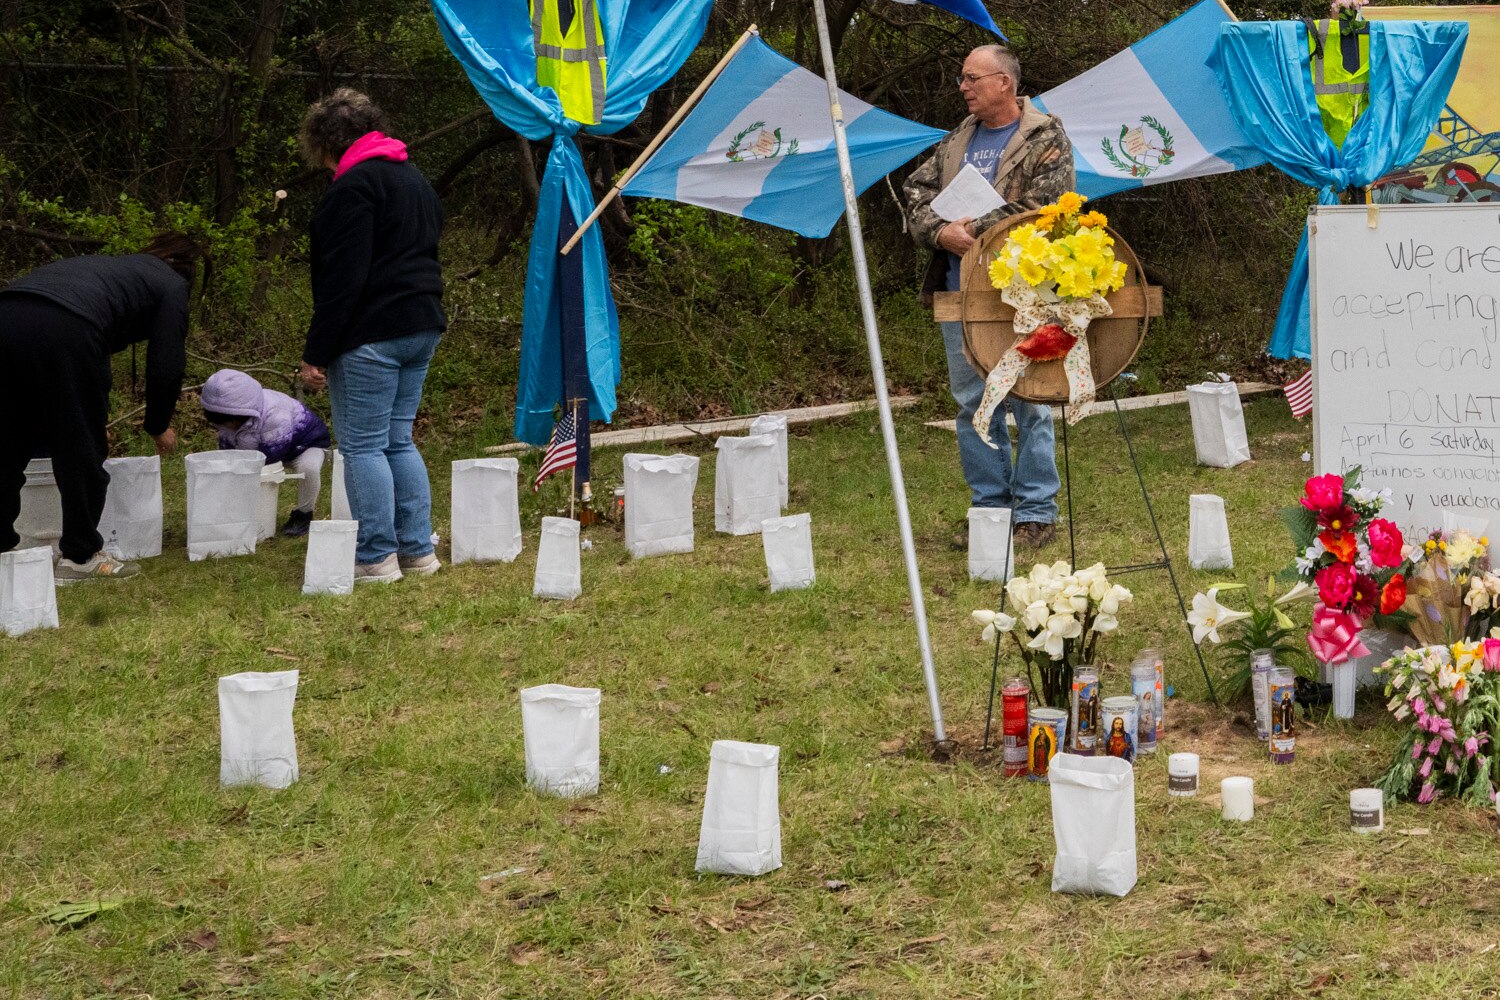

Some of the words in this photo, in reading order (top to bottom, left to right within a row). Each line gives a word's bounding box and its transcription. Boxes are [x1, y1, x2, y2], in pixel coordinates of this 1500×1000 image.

[1386, 238, 1435, 271] We
[1332, 273, 1498, 343] accepting
[1331, 329, 1391, 372] and
[1340, 424, 1388, 456] April
[1399, 429, 1415, 449] 6
[1430, 427, 1495, 464] Saturday
